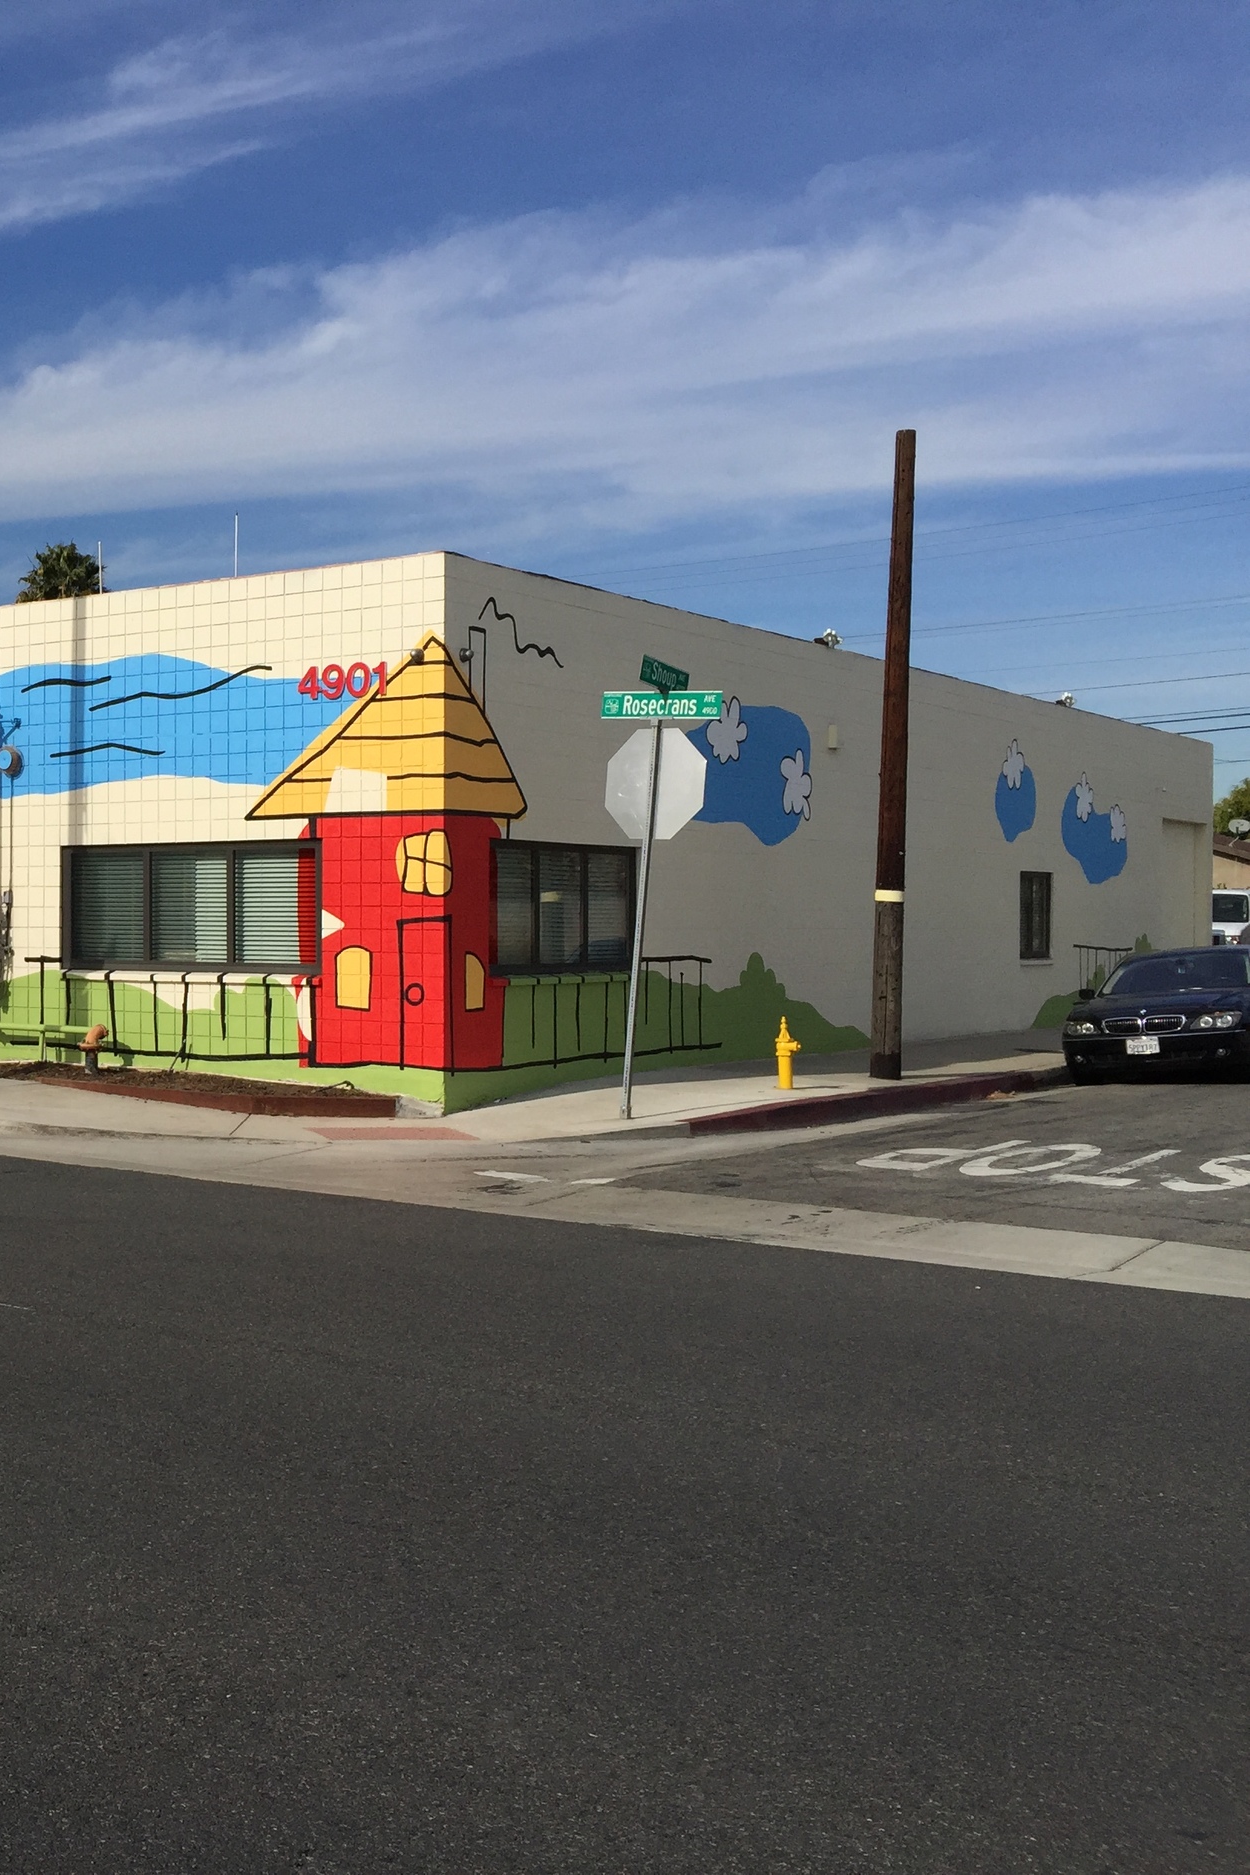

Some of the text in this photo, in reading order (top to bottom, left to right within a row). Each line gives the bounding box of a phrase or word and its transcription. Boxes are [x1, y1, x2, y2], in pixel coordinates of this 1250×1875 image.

[297, 661, 387, 700] 4901
[651, 661, 677, 691] Shoup
[622, 695, 717, 716] Rosecrans AVE
[856, 1139, 1250, 1192] STOP
